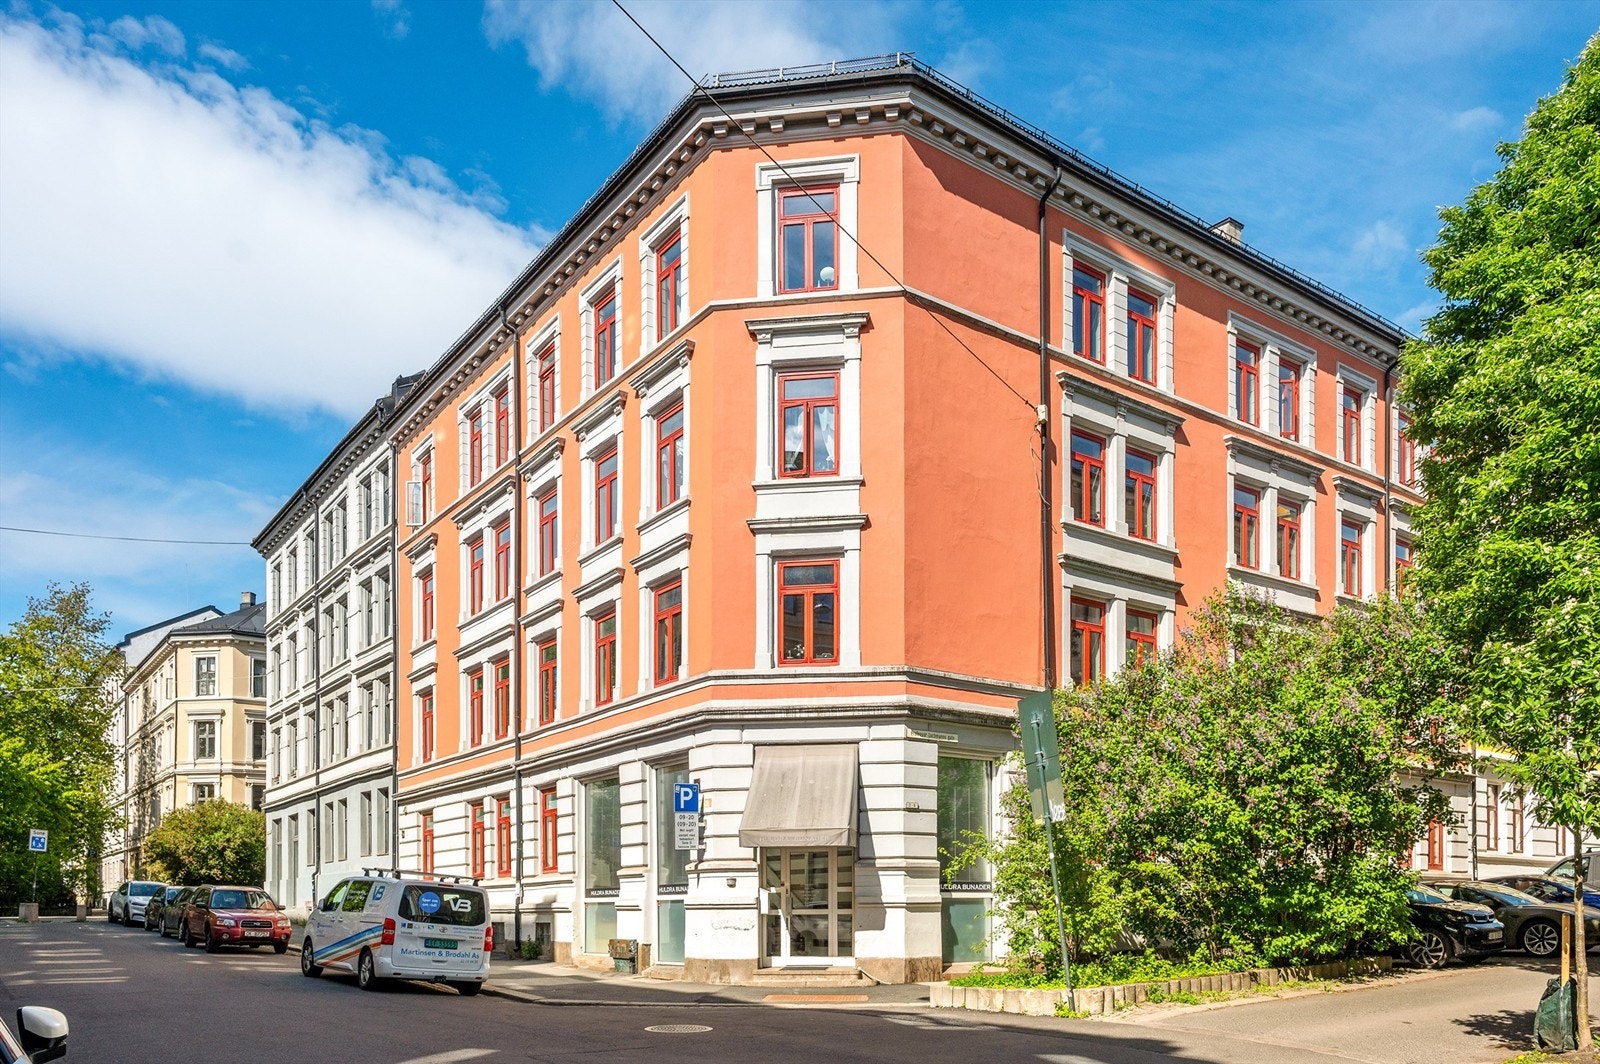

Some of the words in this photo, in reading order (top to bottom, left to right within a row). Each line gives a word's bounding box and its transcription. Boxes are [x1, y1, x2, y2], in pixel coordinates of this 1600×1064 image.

[680, 787, 693, 809] P
[400, 948, 436, 957] Martinsen
[445, 950, 471, 959] Brodahl
[471, 952, 480, 960] As
